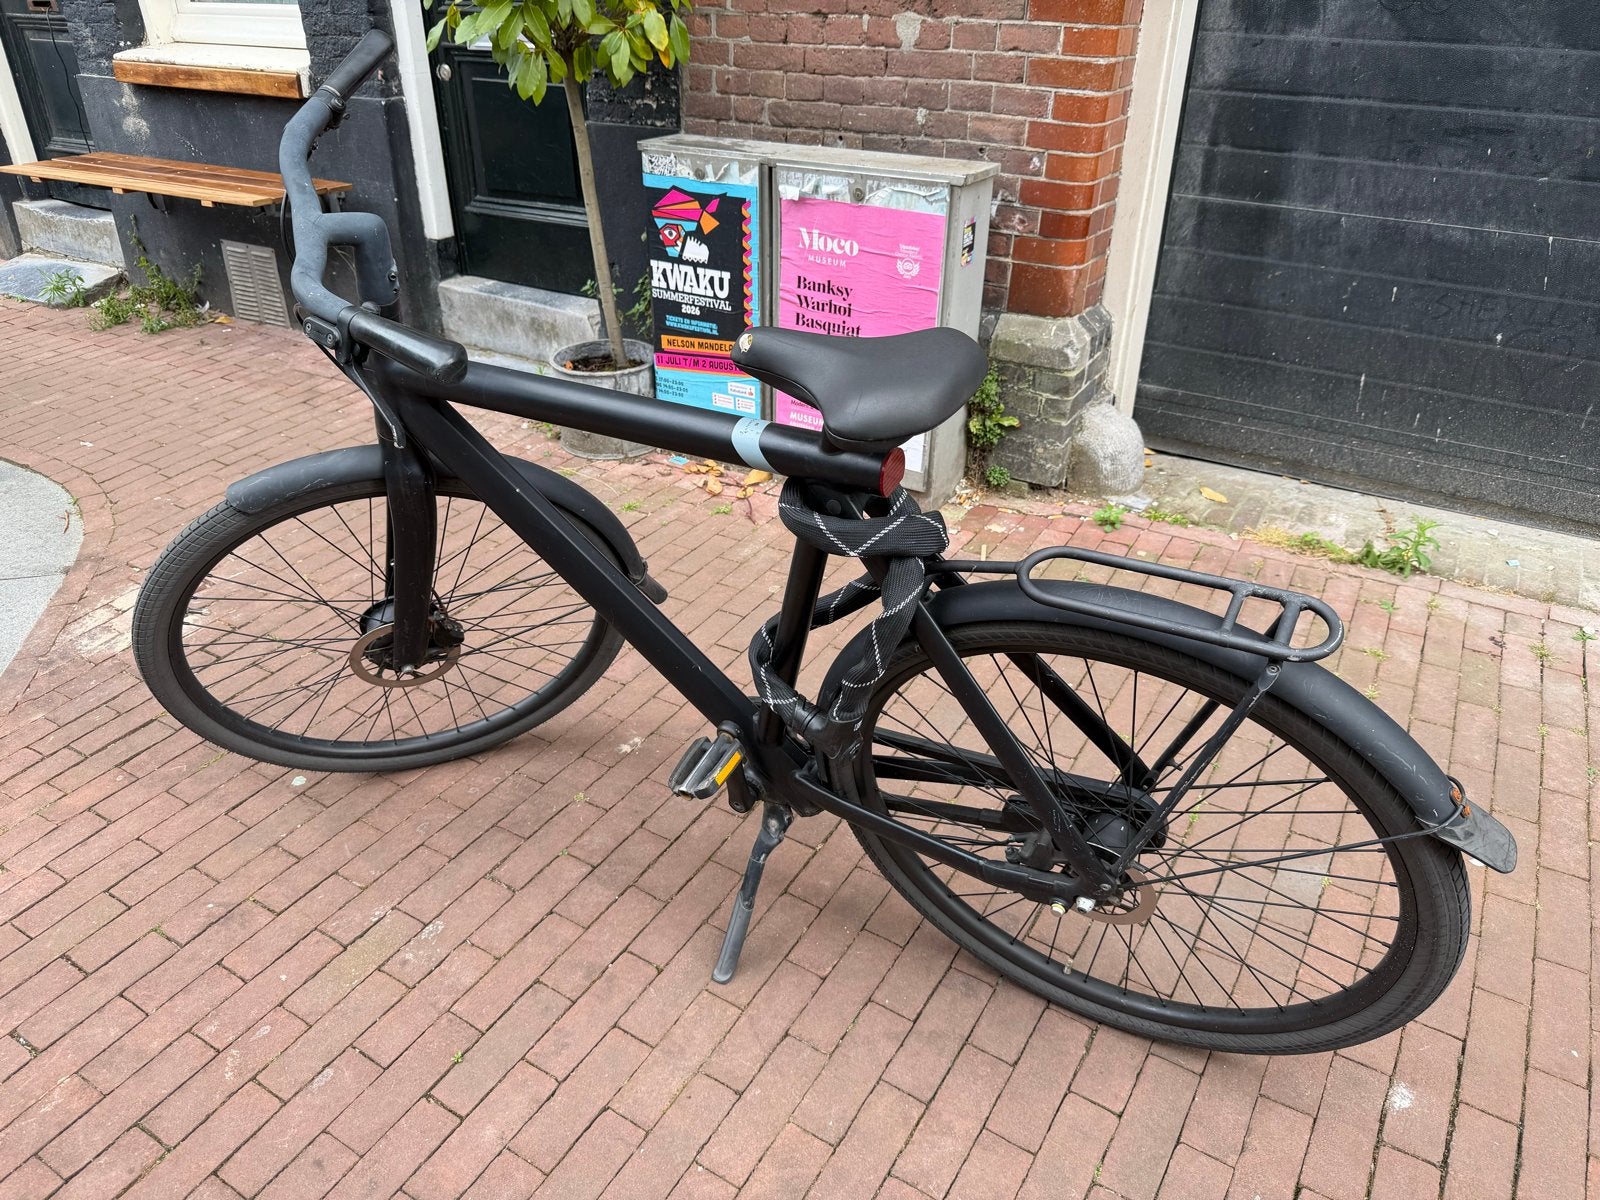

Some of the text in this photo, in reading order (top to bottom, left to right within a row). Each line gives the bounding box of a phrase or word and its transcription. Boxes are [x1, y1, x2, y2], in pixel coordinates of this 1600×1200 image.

[798, 227, 859, 257] Moco
[808, 254, 847, 268] MUSEUM
[650, 259, 731, 299] KWAKU
[797, 275, 853, 301] Banksy
[651, 288, 732, 311] SUMMERFESTIVAL
[681, 304, 700, 316] 2026
[796, 294, 852, 318] Warhol
[795, 312, 861, 337] Basquiat
[666, 338, 734, 352] NELSON MANDELA
[656, 355, 738, 371] 11 JULI T/M 2 AUGUST
